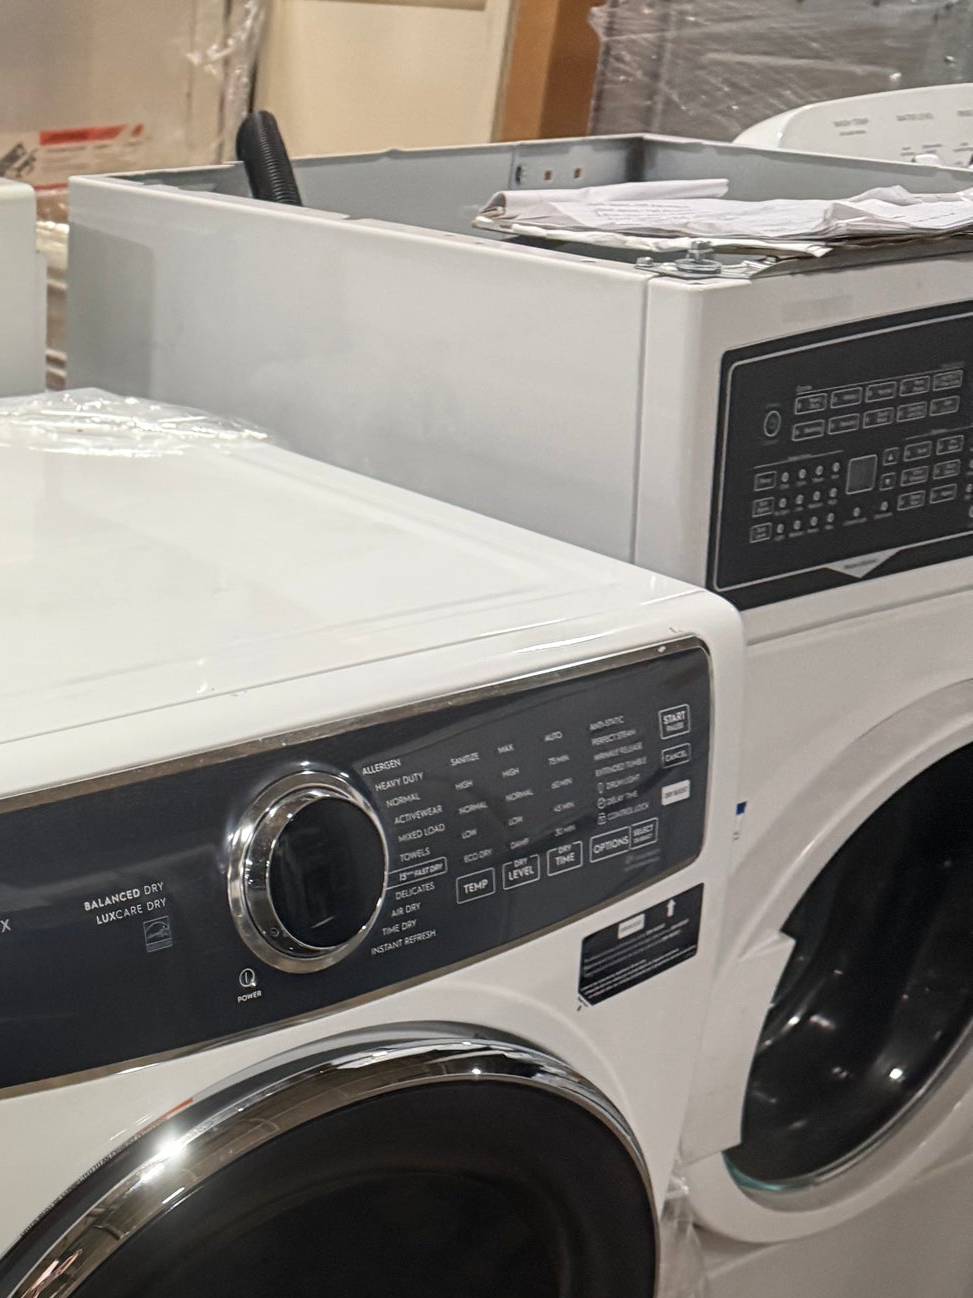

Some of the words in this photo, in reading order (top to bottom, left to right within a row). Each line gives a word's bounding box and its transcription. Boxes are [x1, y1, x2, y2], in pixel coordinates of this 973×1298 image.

[663, 710, 686, 725] START
[544, 730, 563, 741] AUTO
[497, 743, 515, 754] MAX
[362, 758, 402, 776] ALLERGEN
[450, 751, 480, 767] SANITIZE
[502, 767, 520, 778] HIGH
[374, 777, 402, 792] HEAVY
[402, 771, 424, 785] DUTY
[455, 779, 474, 791] HIGH
[386, 792, 422, 808] NORMAL
[505, 788, 534, 802] NORMAL
[394, 804, 443, 825] ACTIVEWEAR
[458, 801, 488, 814] NORMAL
[508, 815, 523, 826] LOW
[398, 829, 423, 843] MIXED
[424, 823, 446, 837] LOAD
[461, 828, 477, 840] LOW
[557, 843, 572, 854] DRY
[593, 835, 629, 854] OPTIONS
[399, 846, 431, 862] TOWELS
[555, 852, 576, 866] TIME
[513, 857, 528, 868] DRY
[508, 865, 535, 881] LEVEL
[395, 881, 435, 900] DELICATES
[463, 878, 489, 894] TEMP
[83, 887, 141, 912] BALANCED
[142, 881, 165, 897] DRY
[95, 903, 144, 926] LUXCARE
[145, 897, 167, 914] DRY
[391, 907, 405, 918] AIR
[405, 902, 421, 914] DRY
[382, 923, 400, 936] TIME
[401, 919, 417, 931] DRY
[371, 938, 404, 956] INSTANT
[404, 929, 437, 946] REFRESH
[236, 989, 263, 1004] POWER
